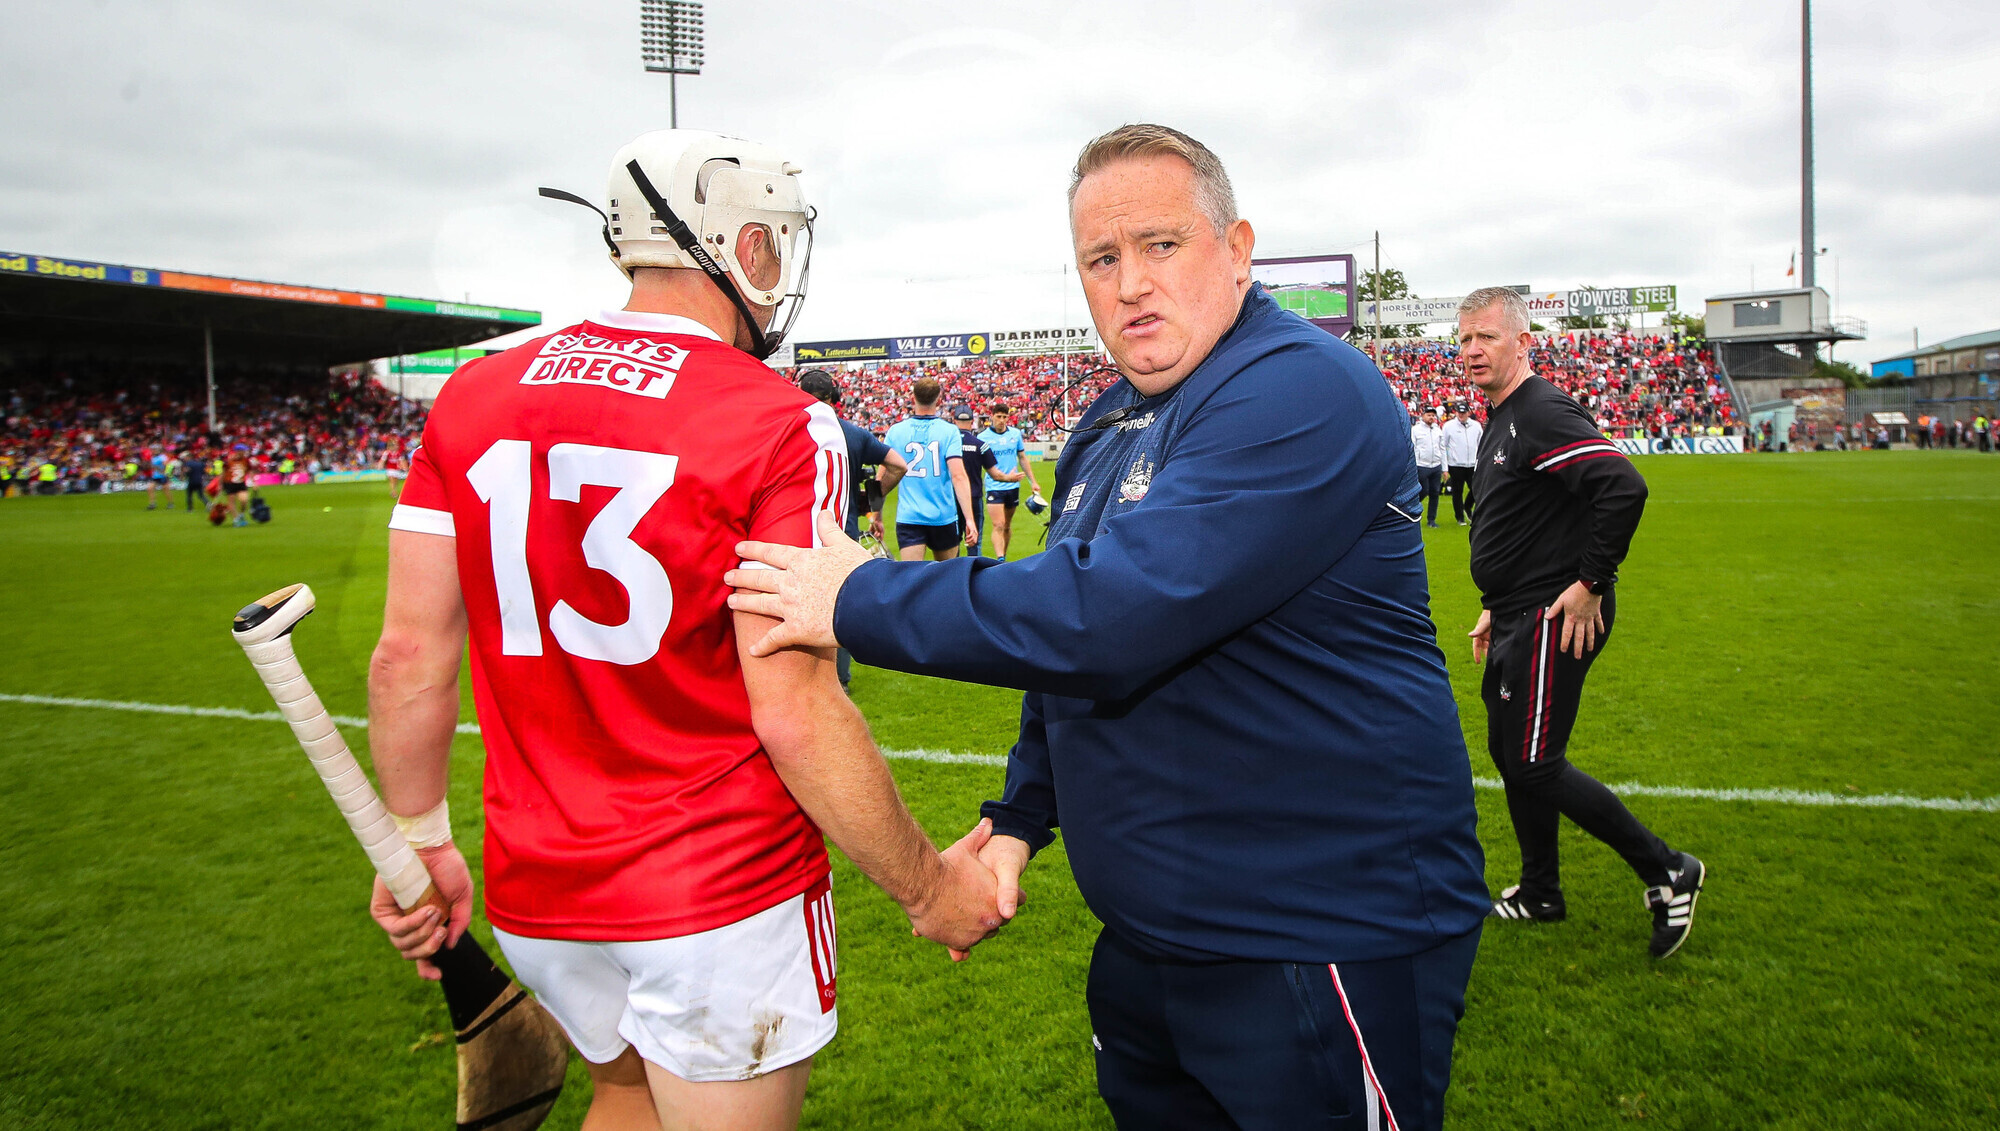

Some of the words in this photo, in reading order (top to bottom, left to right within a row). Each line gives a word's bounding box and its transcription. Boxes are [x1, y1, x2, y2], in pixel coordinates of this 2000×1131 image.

[35, 258, 107, 281] Steel
[1570, 289, 1629, 307] O'DWYER
[1636, 287, 1675, 303] STEEL
[435, 302, 455, 316] FBD
[456, 306, 500, 320] INSURANCE
[1382, 304, 1412, 312] HORSE
[1423, 302, 1458, 310] JOCKEY
[1595, 304, 1649, 315] Dundrum
[994, 328, 1089, 341] DARMODY
[860, 345, 885, 355] Ireland
[896, 337, 933, 350] VALE
[936, 336, 964, 349] OIL
[995, 339, 1047, 348] SPORTS
[1055, 338, 1088, 346] TURF
[530, 356, 665, 392] DIRECT
[904, 440, 941, 478] 21
[466, 438, 680, 666] 13
